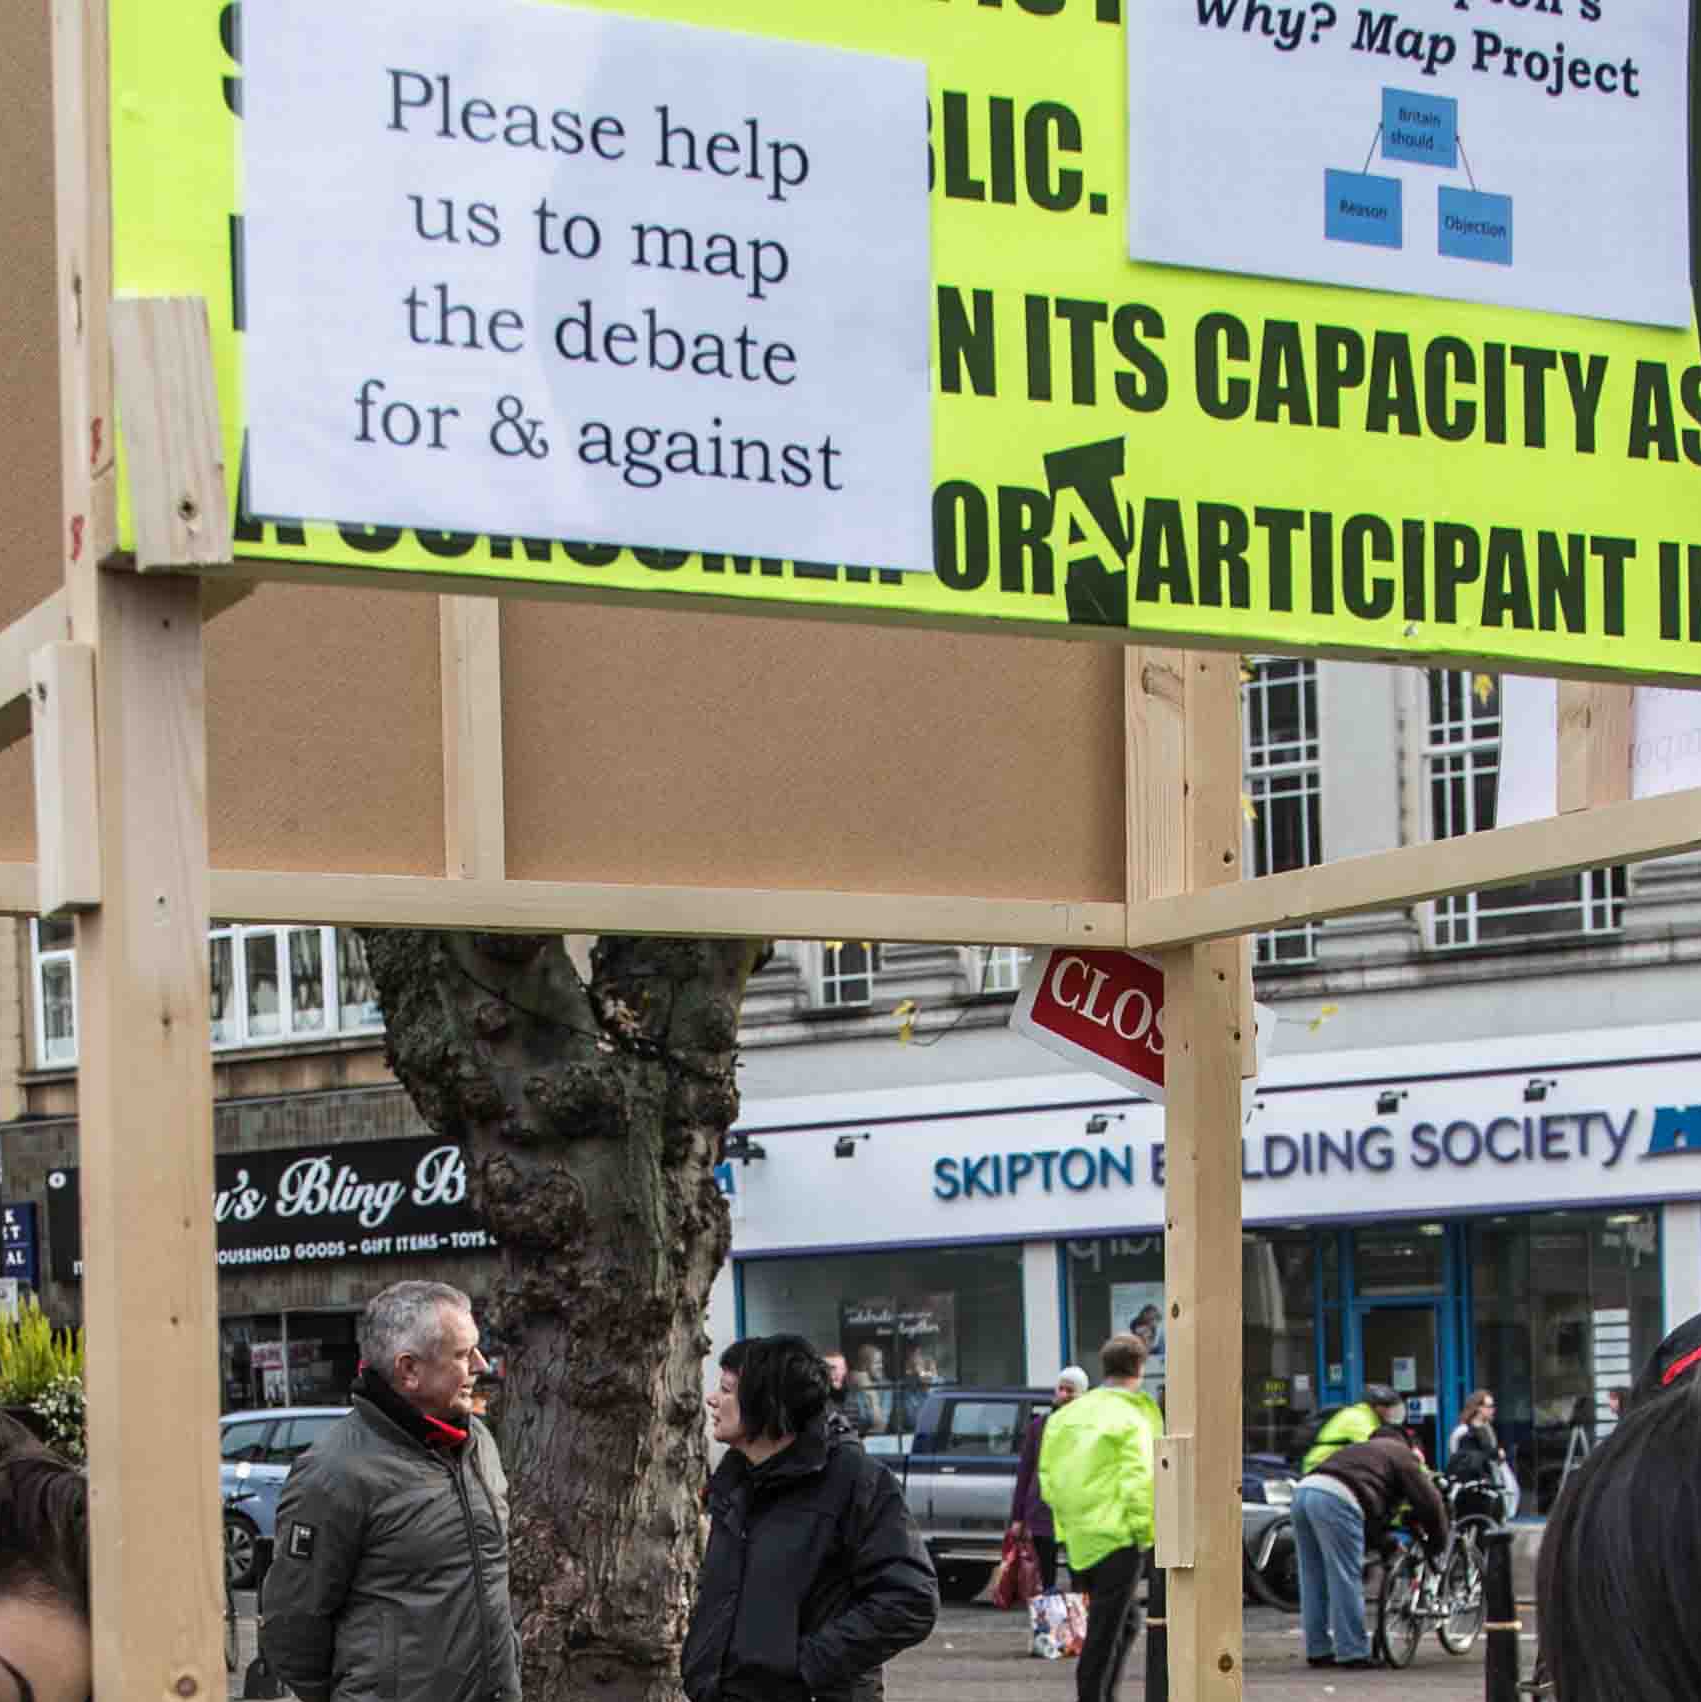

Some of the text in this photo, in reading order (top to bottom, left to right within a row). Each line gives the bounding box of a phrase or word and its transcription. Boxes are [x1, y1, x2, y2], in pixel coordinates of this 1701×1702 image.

[1197, 0, 1639, 97] Why? Map Project
[385, 68, 810, 201] Please help
[1390, 130, 1435, 152] should
[1399, 106, 1443, 129] Britain
[407, 193, 792, 299] us to map
[1338, 200, 1388, 221] Reason
[1444, 215, 1507, 240] Objection
[404, 285, 797, 385] the debate
[1025, 294, 1168, 413] ITS
[1193, 311, 1609, 454] CAPACITY
[354, 380, 843, 491] for & against
[932, 480, 1055, 595] OR
[1126, 495, 1636, 638] ARTICIPANT
[275, 1153, 406, 1229] Bling
[932, 1143, 1134, 1200] SKIPTON
[1410, 1107, 1638, 1171] SOCIETY
[216, 1243, 291, 1266] OUSEHOLD
[294, 1240, 346, 1261] GOODS
[361, 1236, 393, 1256] GIFT
[396, 1234, 439, 1254] ITEMS
[450, 1230, 486, 1248] TOYS
